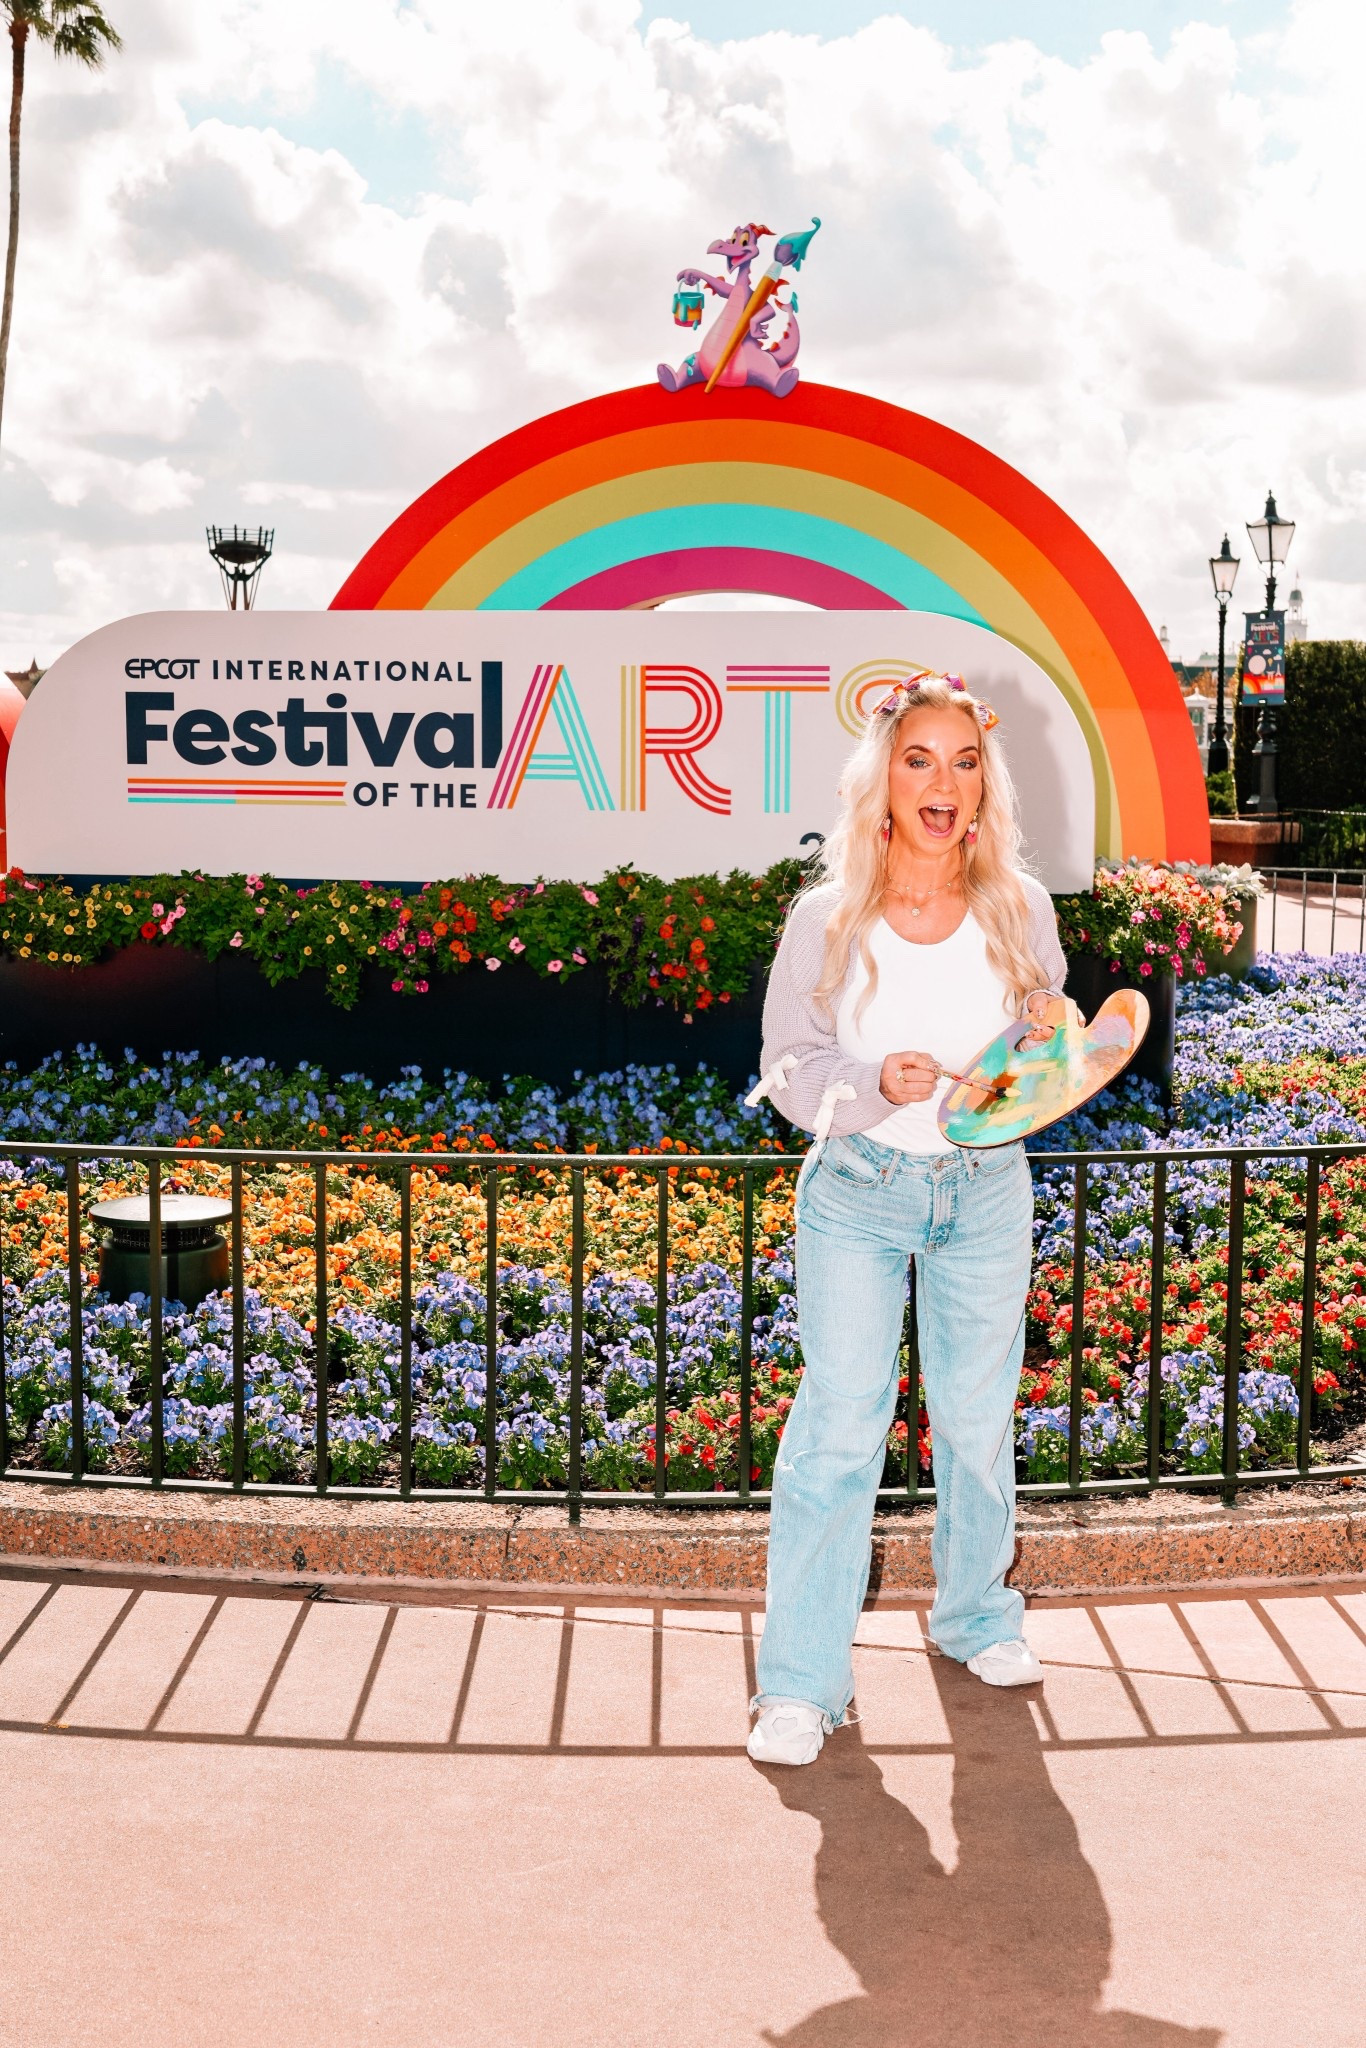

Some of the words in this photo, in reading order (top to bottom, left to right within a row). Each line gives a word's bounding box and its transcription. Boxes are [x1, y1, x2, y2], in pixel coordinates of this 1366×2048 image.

[125, 658, 200, 680] EPCOT
[213, 660, 472, 682] INTERNATIONAL
[125, 661, 503, 769] Festival
[353, 781, 398, 808] OF
[411, 783, 478, 808] THE
